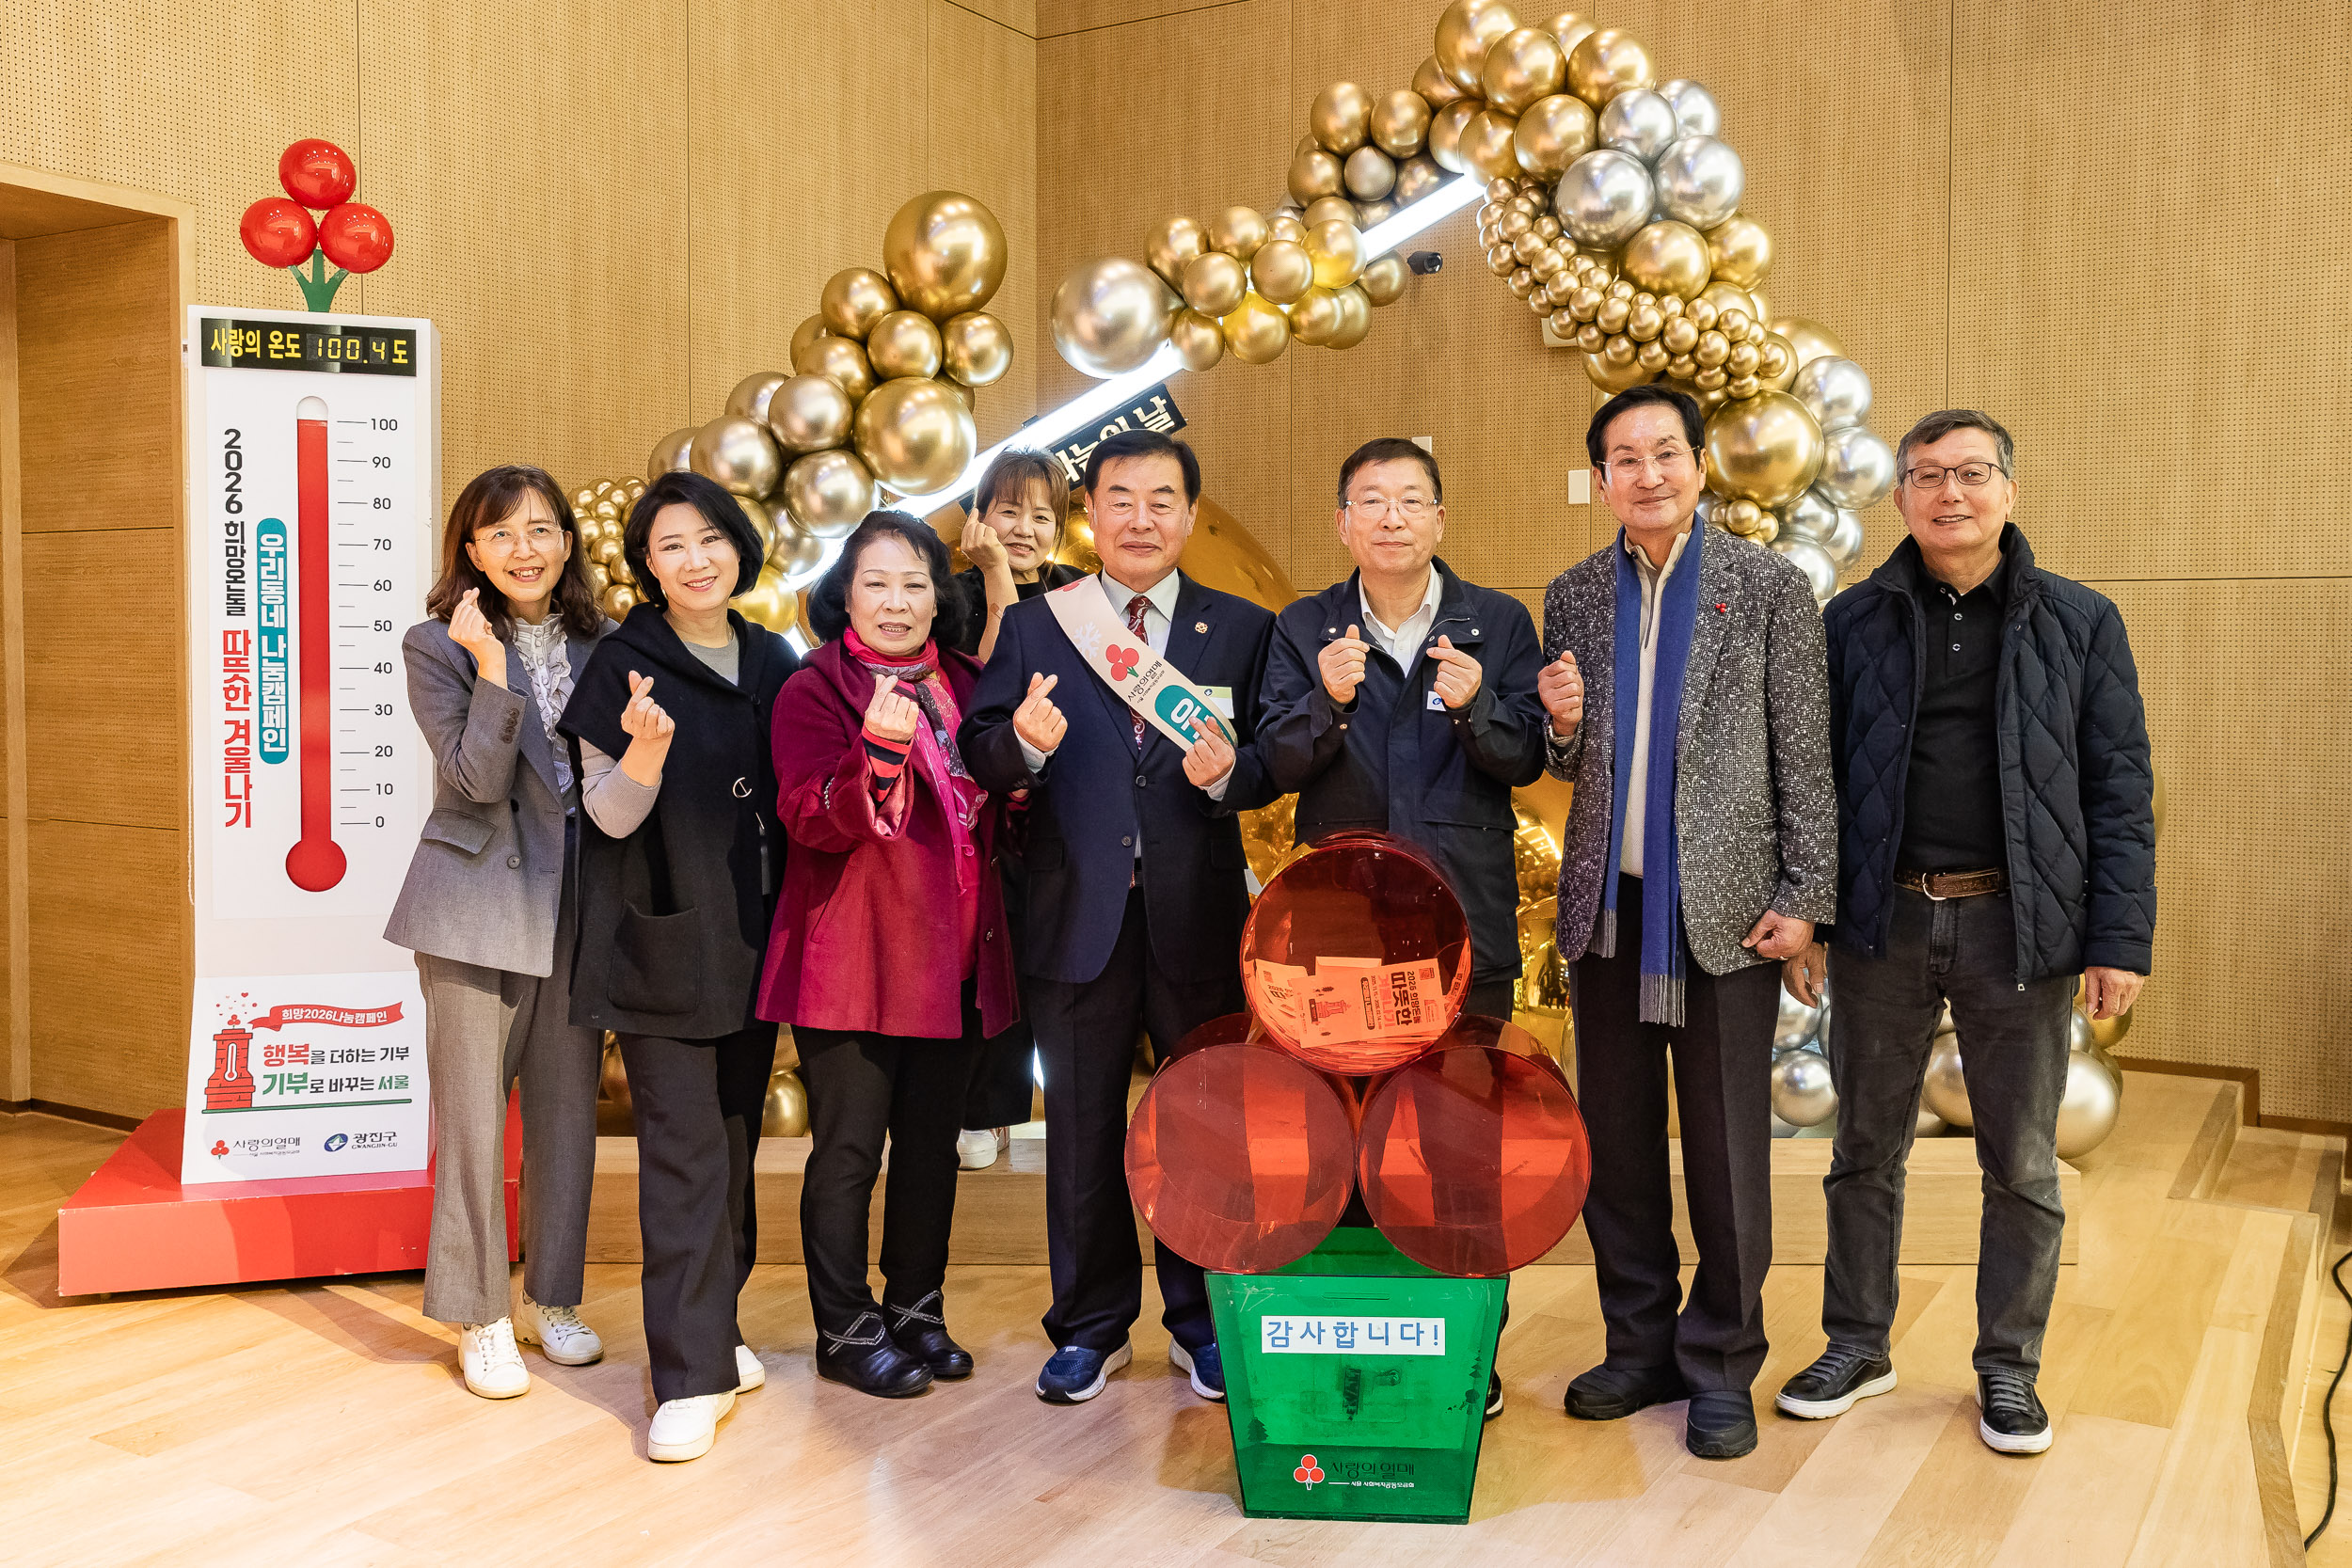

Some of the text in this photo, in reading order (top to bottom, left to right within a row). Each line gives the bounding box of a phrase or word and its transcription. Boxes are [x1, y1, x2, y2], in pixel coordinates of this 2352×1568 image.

[211, 328, 261, 358] 사랑의
[268, 330, 302, 359] 온도
[1132, 395, 1176, 433] 날
[371, 419, 398, 431] 100
[372, 456, 390, 468] 90
[373, 498, 391, 510] 80
[224, 428, 246, 617] 2026 희망온돌
[373, 539, 391, 551] 70
[373, 580, 392, 592] 60
[373, 621, 392, 632] 50
[260, 532, 287, 753] 우리동네 나눔캠페인
[374, 662, 392, 673] 40
[374, 704, 393, 716] 30
[222, 629, 253, 829] 따뜻한 겨울나기
[374, 746, 393, 757] 20
[375, 784, 393, 795] 10
[375, 816, 384, 828] 0
[1391, 972, 1412, 1025] 따뜻한
[263, 1043, 409, 1067] 행복을 더하는 기부
[262, 1072, 409, 1096] 기부로 바꾸는 서울
[353, 1132, 398, 1144] 광진구
[1266, 1321, 1438, 1349] 감사합니다!
